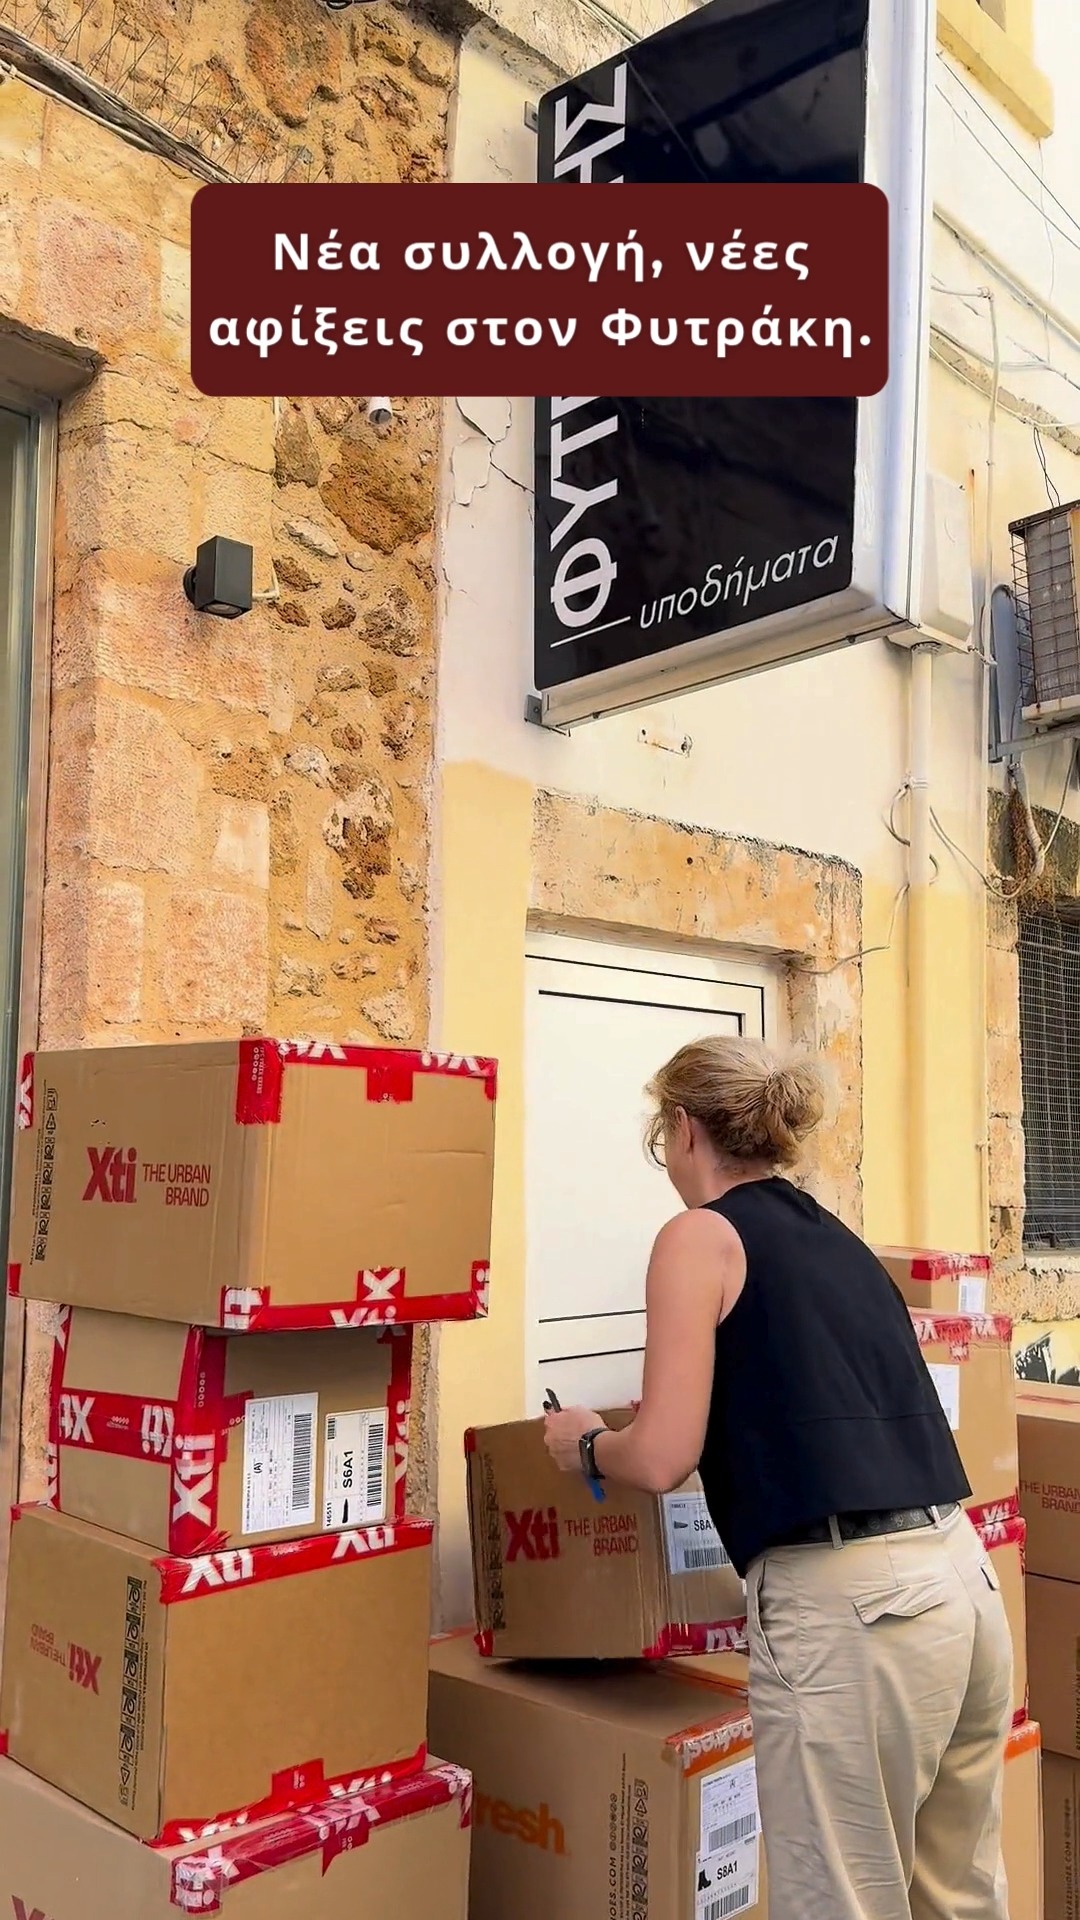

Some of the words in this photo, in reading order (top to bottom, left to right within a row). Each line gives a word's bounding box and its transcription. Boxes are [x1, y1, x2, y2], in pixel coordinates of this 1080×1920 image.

[639, 535, 839, 629] υποδήματα
[82, 1146, 137, 1203] Xti
[142, 1163, 166, 1182] THE
[167, 1163, 211, 1184] URBAN
[165, 1186, 209, 1207] BRAND
[172, 1433, 216, 1523] Xti
[343, 1450, 353, 1489] S6A1
[504, 1506, 560, 1562] Xti
[564, 1517, 590, 1537] THE
[593, 1513, 638, 1536] URBAN
[693, 1519, 714, 1532] S8A
[593, 1536, 639, 1557] BRAND
[68, 1643, 102, 1696] Xti
[475, 1793, 566, 1856] resh
[717, 1860, 738, 1881] S8A1
